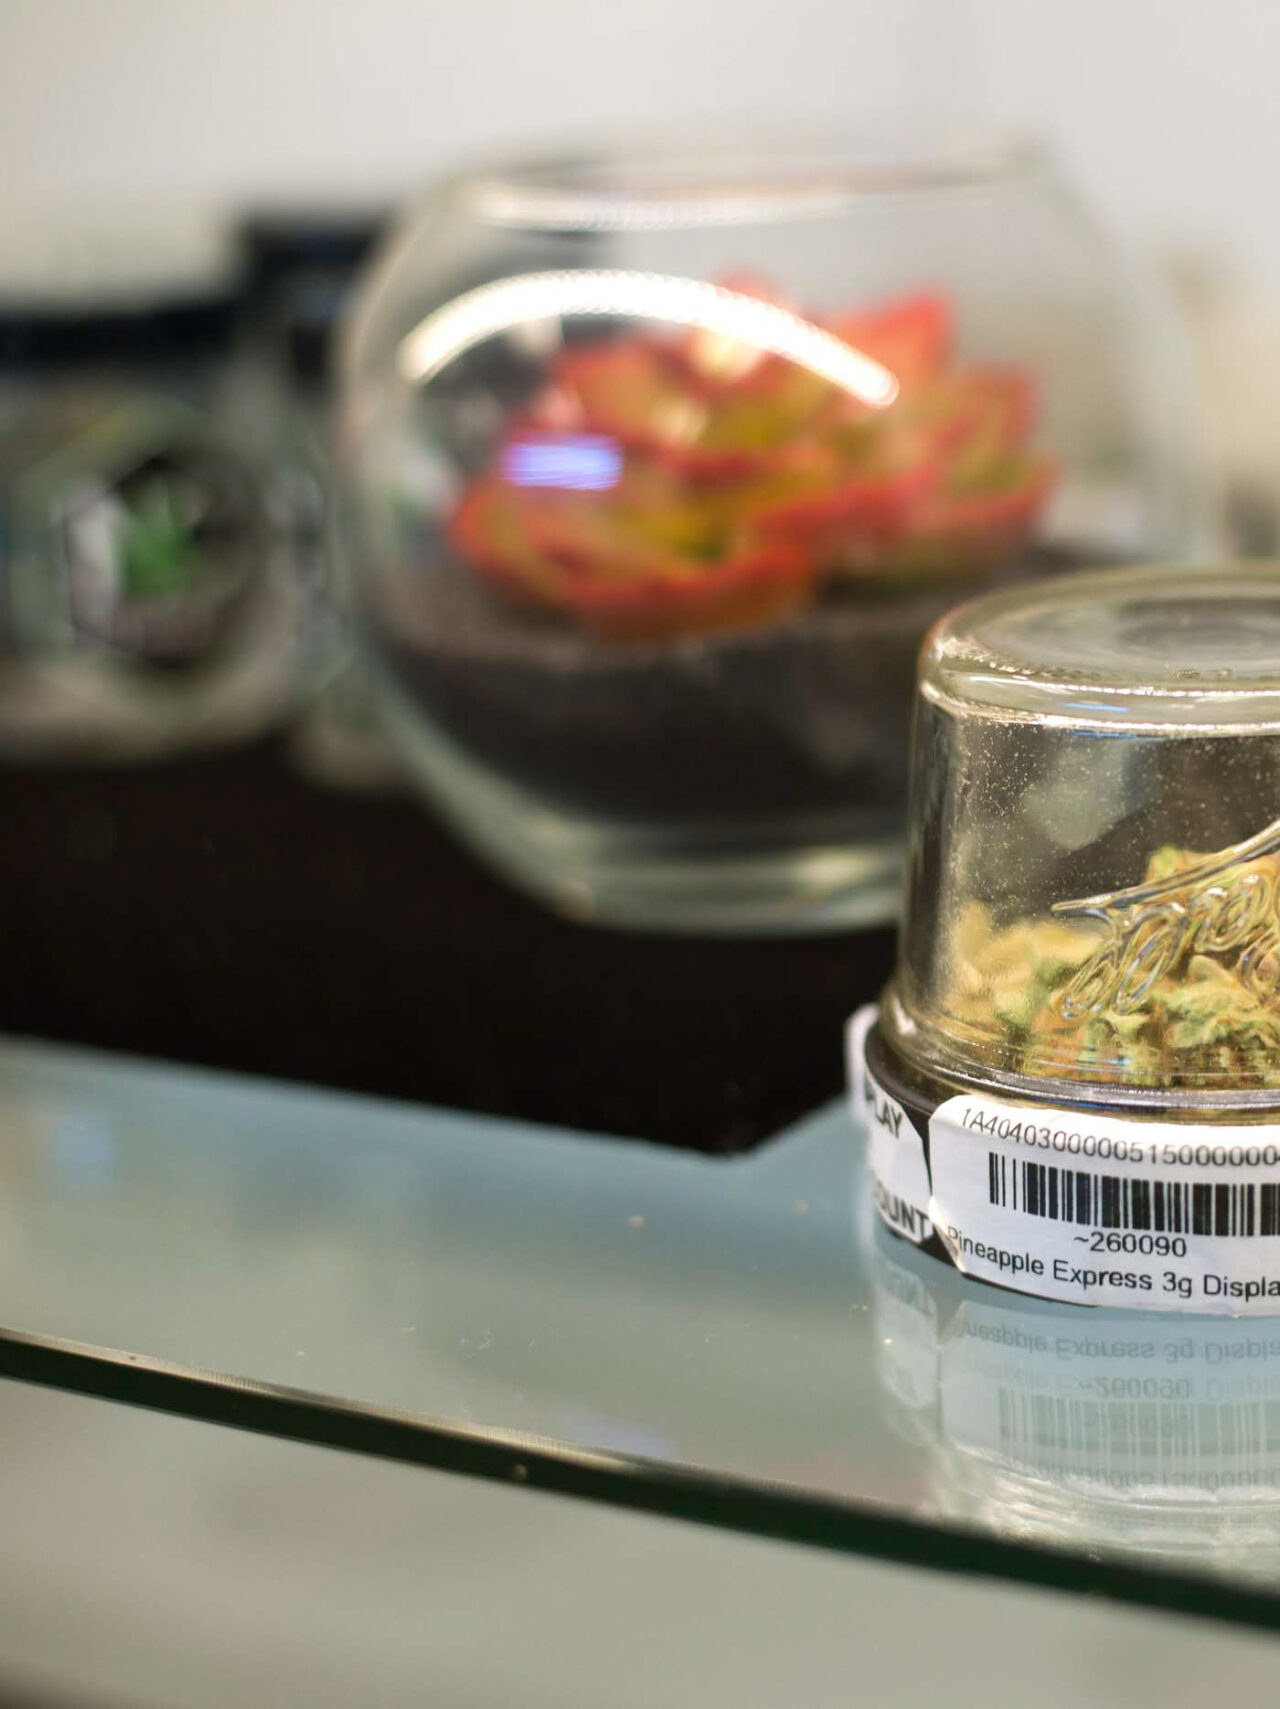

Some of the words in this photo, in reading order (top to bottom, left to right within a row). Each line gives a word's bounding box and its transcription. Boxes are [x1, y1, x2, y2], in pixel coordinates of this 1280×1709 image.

[947, 1224, 1045, 1277] Pineapple
[1053, 1260, 1153, 1291] Express
[1162, 1271, 1193, 1298] 3g
[1073, 1231, 1187, 1259] ~260090
